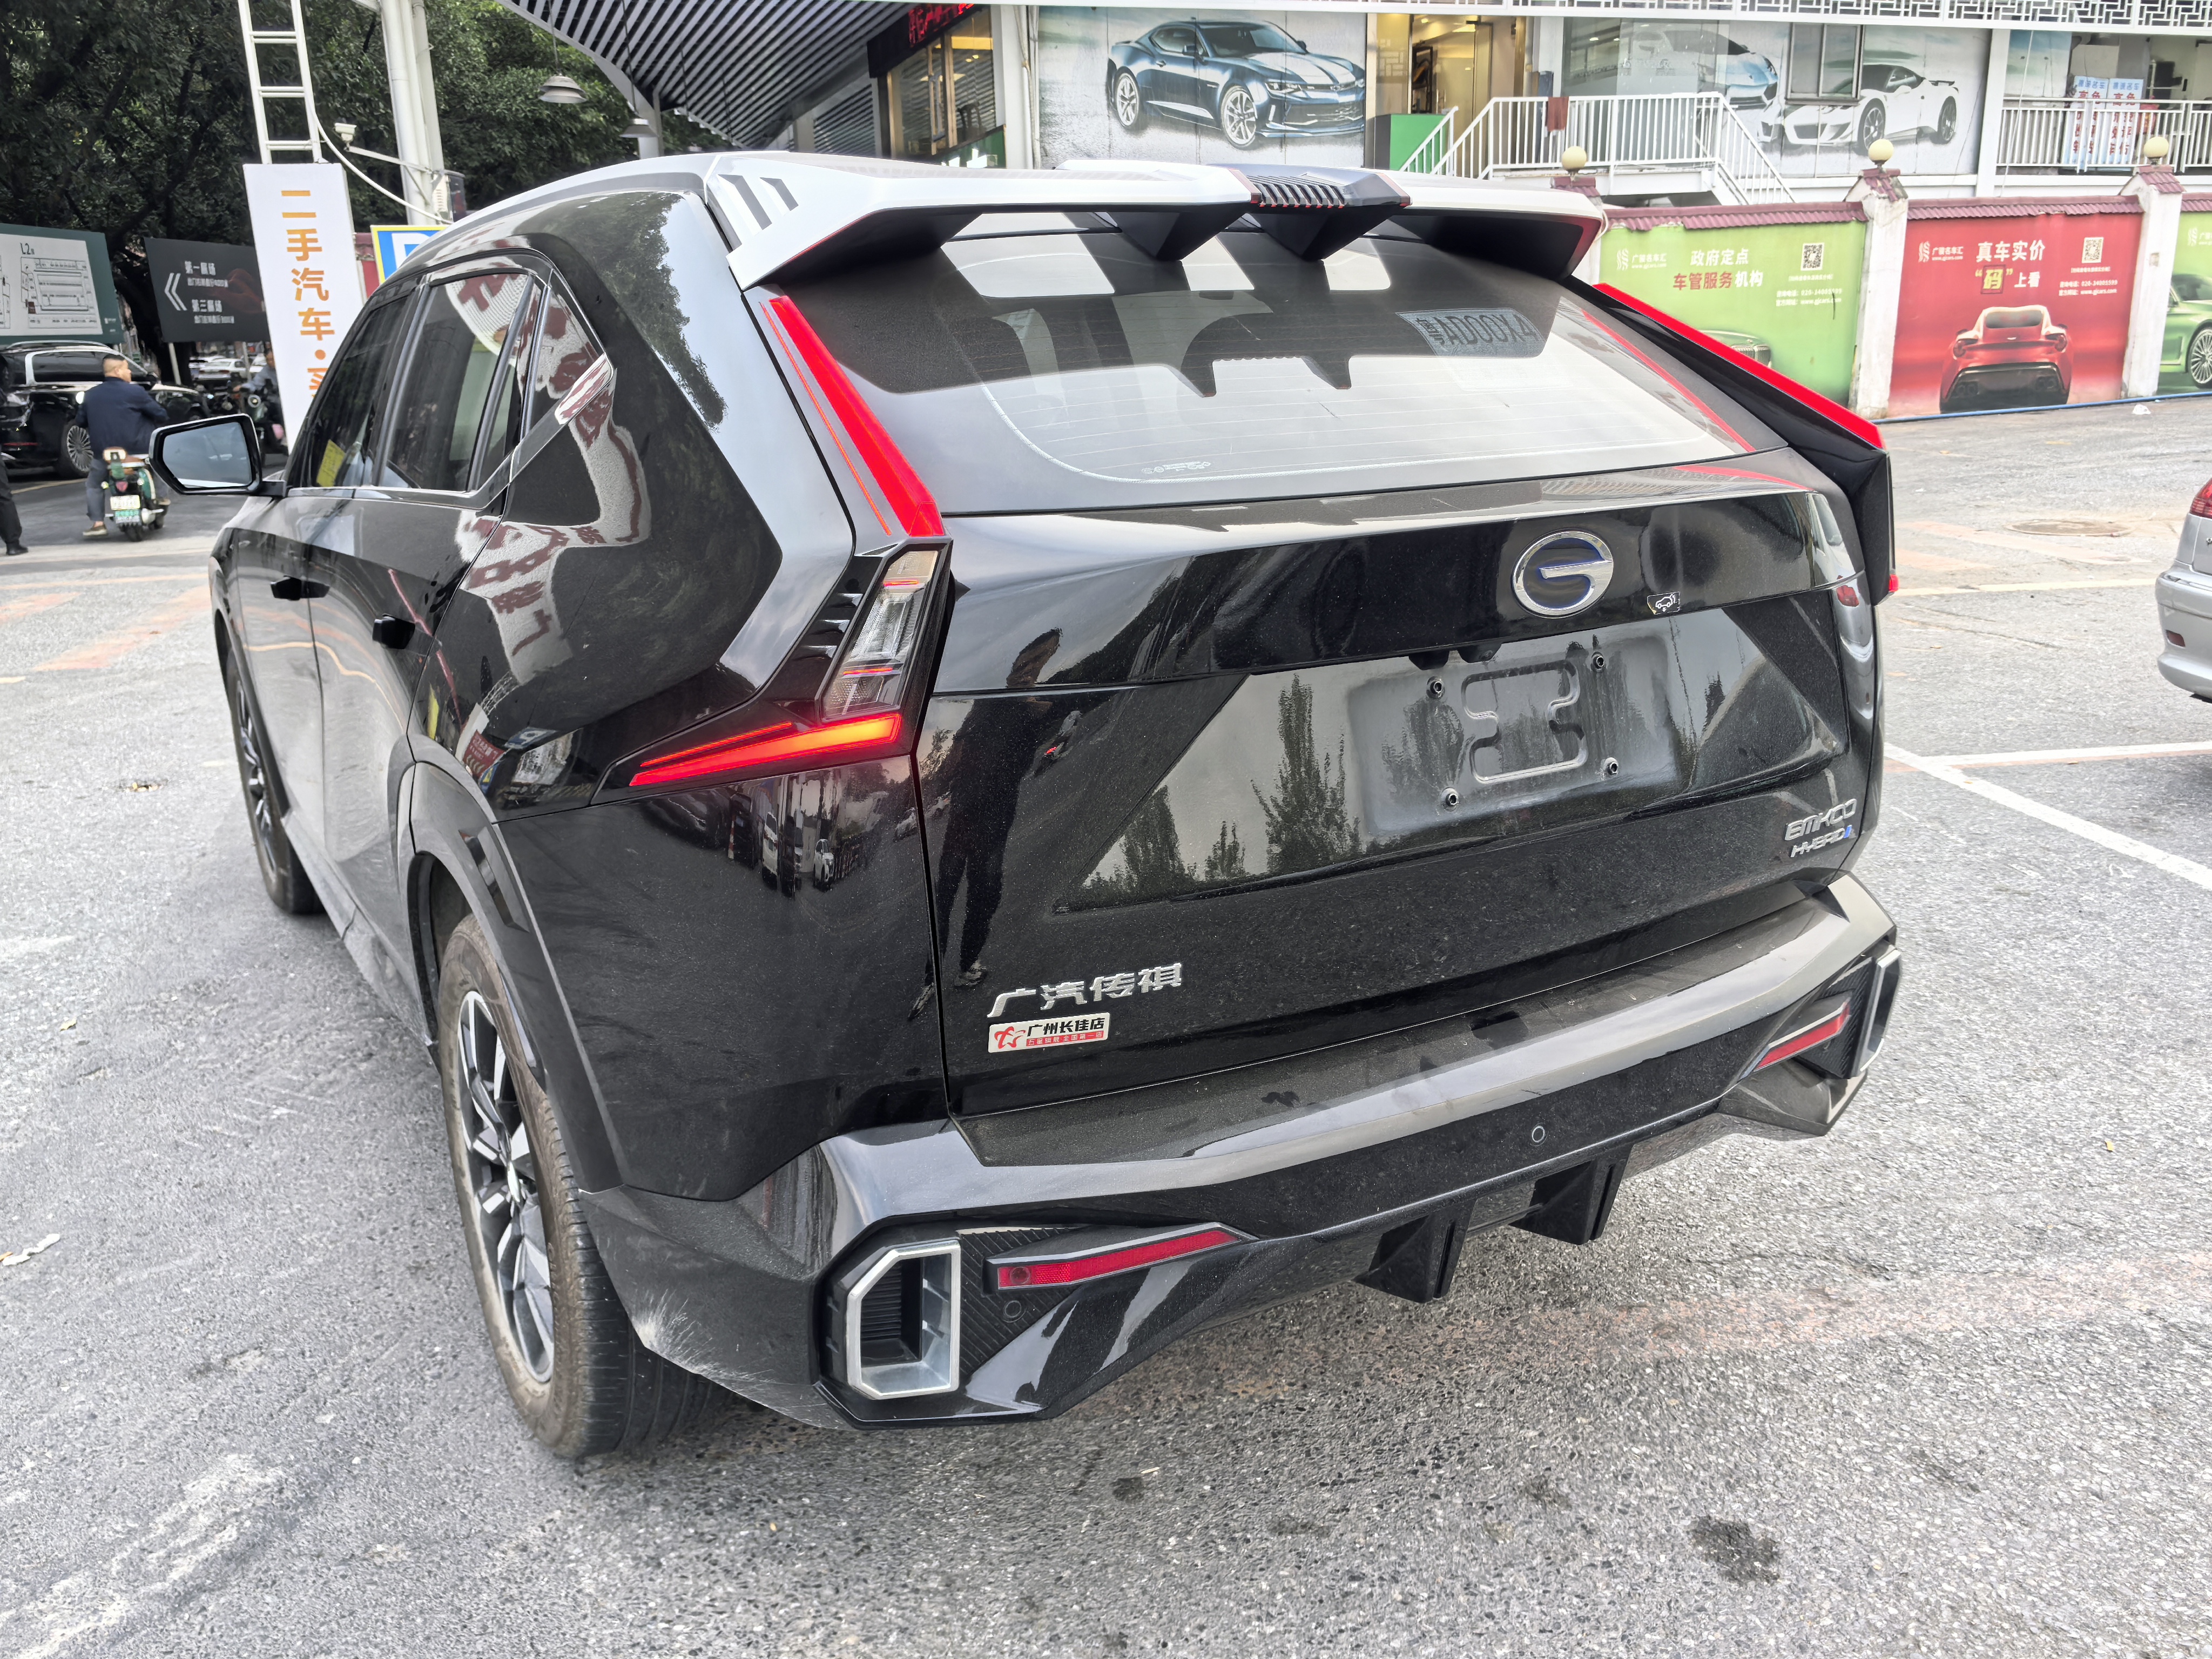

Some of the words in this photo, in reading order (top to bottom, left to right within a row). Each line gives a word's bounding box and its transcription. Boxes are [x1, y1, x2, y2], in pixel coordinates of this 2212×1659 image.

[1690, 248, 1749, 266] 政府定点
[1976, 240, 2045, 262] 真车实价
[1673, 269, 1764, 291] 车管服务机构
[1785, 798, 1857, 841] EMKOO
[987, 962, 1182, 1018] 广汽传祺
[1027, 1017, 1106, 1037] 广州长佳店
